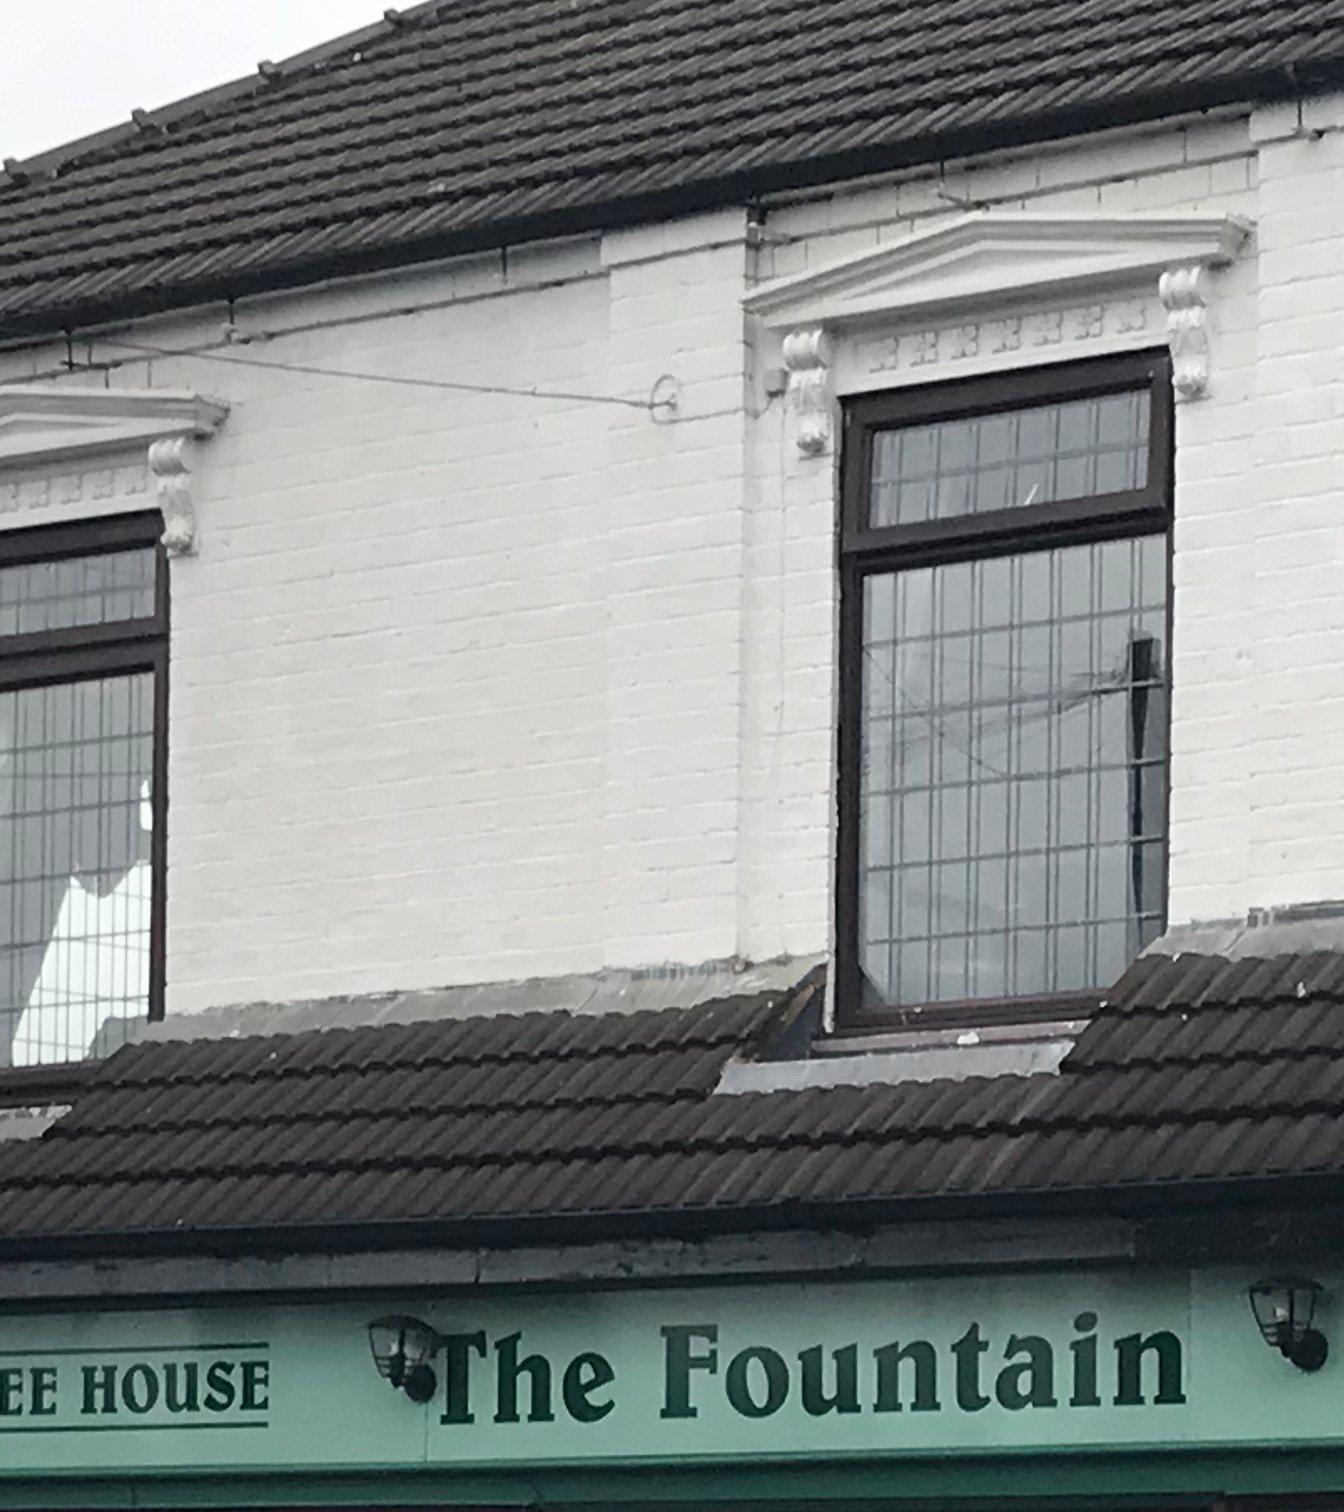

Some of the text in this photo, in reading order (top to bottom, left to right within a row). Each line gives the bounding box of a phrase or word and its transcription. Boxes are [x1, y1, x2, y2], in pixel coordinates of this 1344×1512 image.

[80, 1360, 269, 1415] HOUSE
[436, 1311, 1187, 1426] The Fountain
